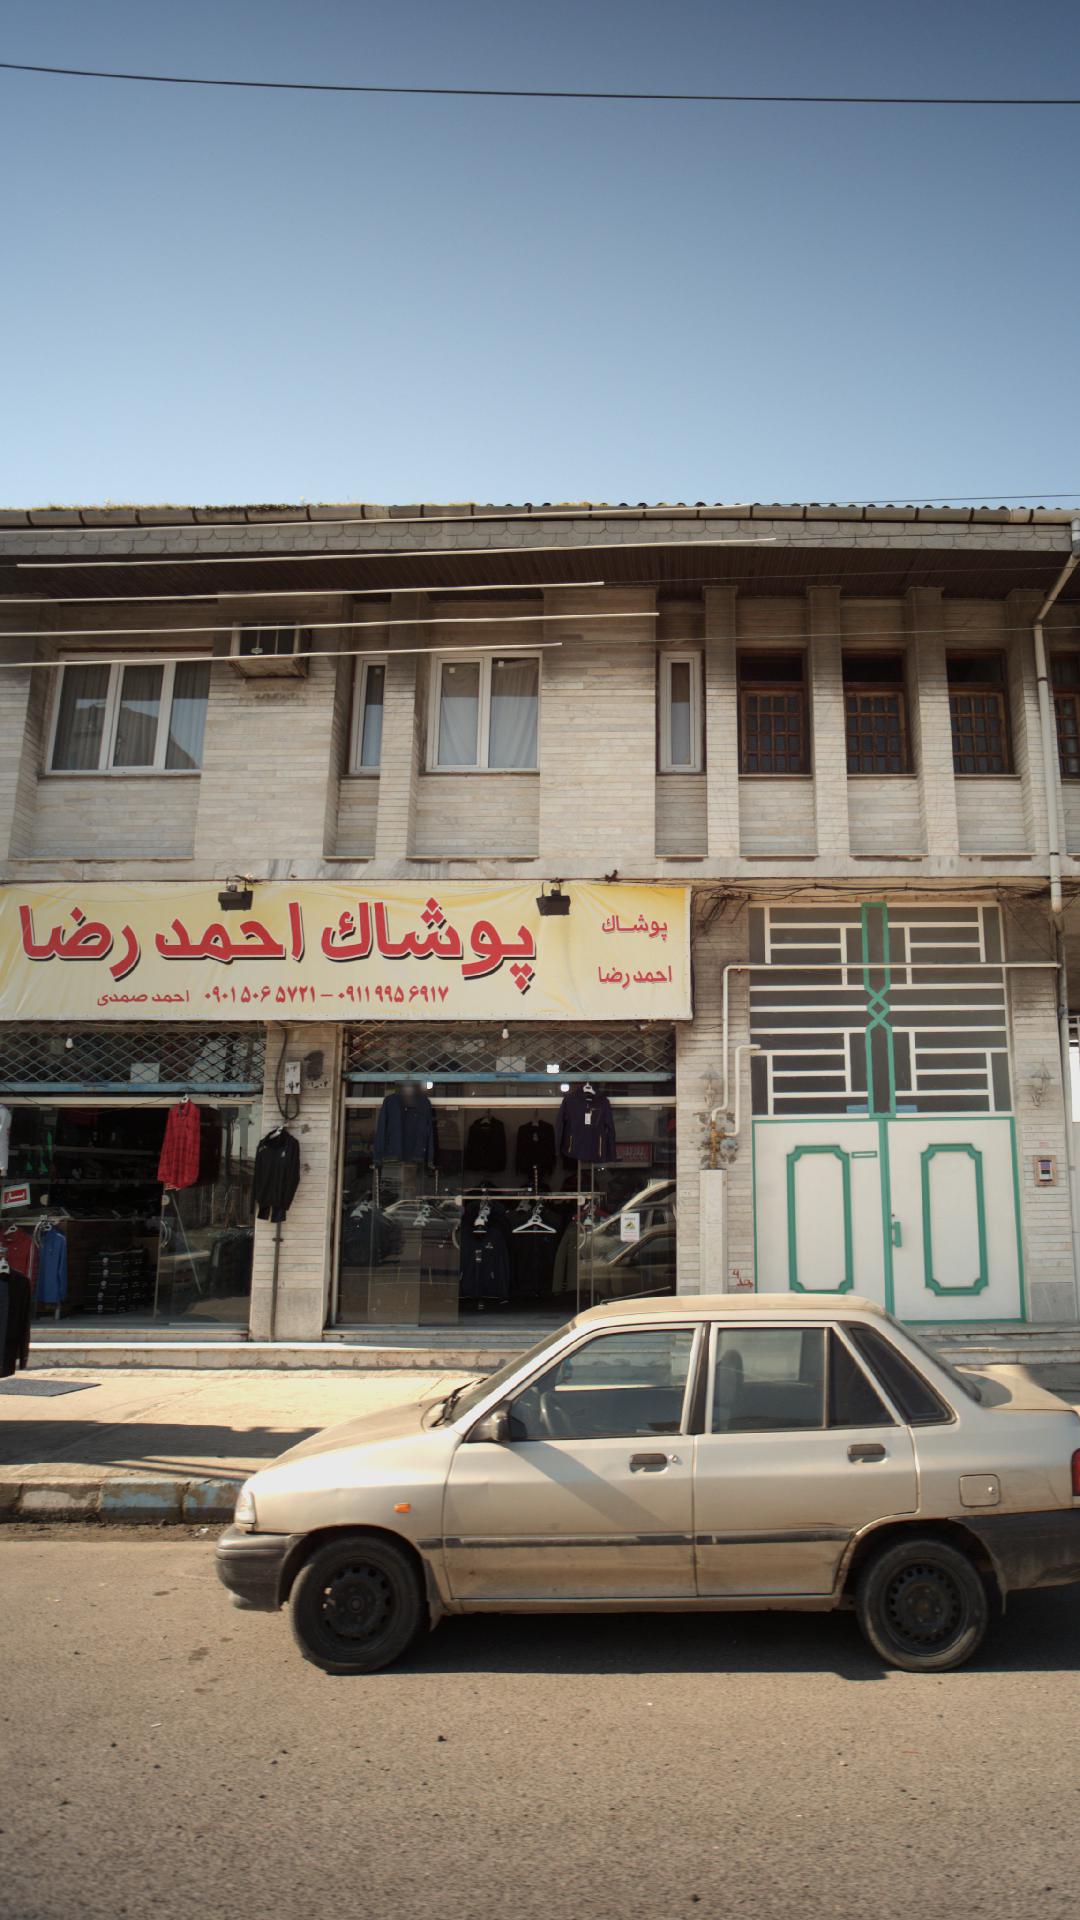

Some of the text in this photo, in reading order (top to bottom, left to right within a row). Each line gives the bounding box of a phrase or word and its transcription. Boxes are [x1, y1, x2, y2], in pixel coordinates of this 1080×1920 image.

[19, 905, 139, 978] رضا
[155, 902, 302, 962] احمد
[97, 990, 190, 1006] احمد صمدی
[598, 965, 672, 989] احمد رضا
